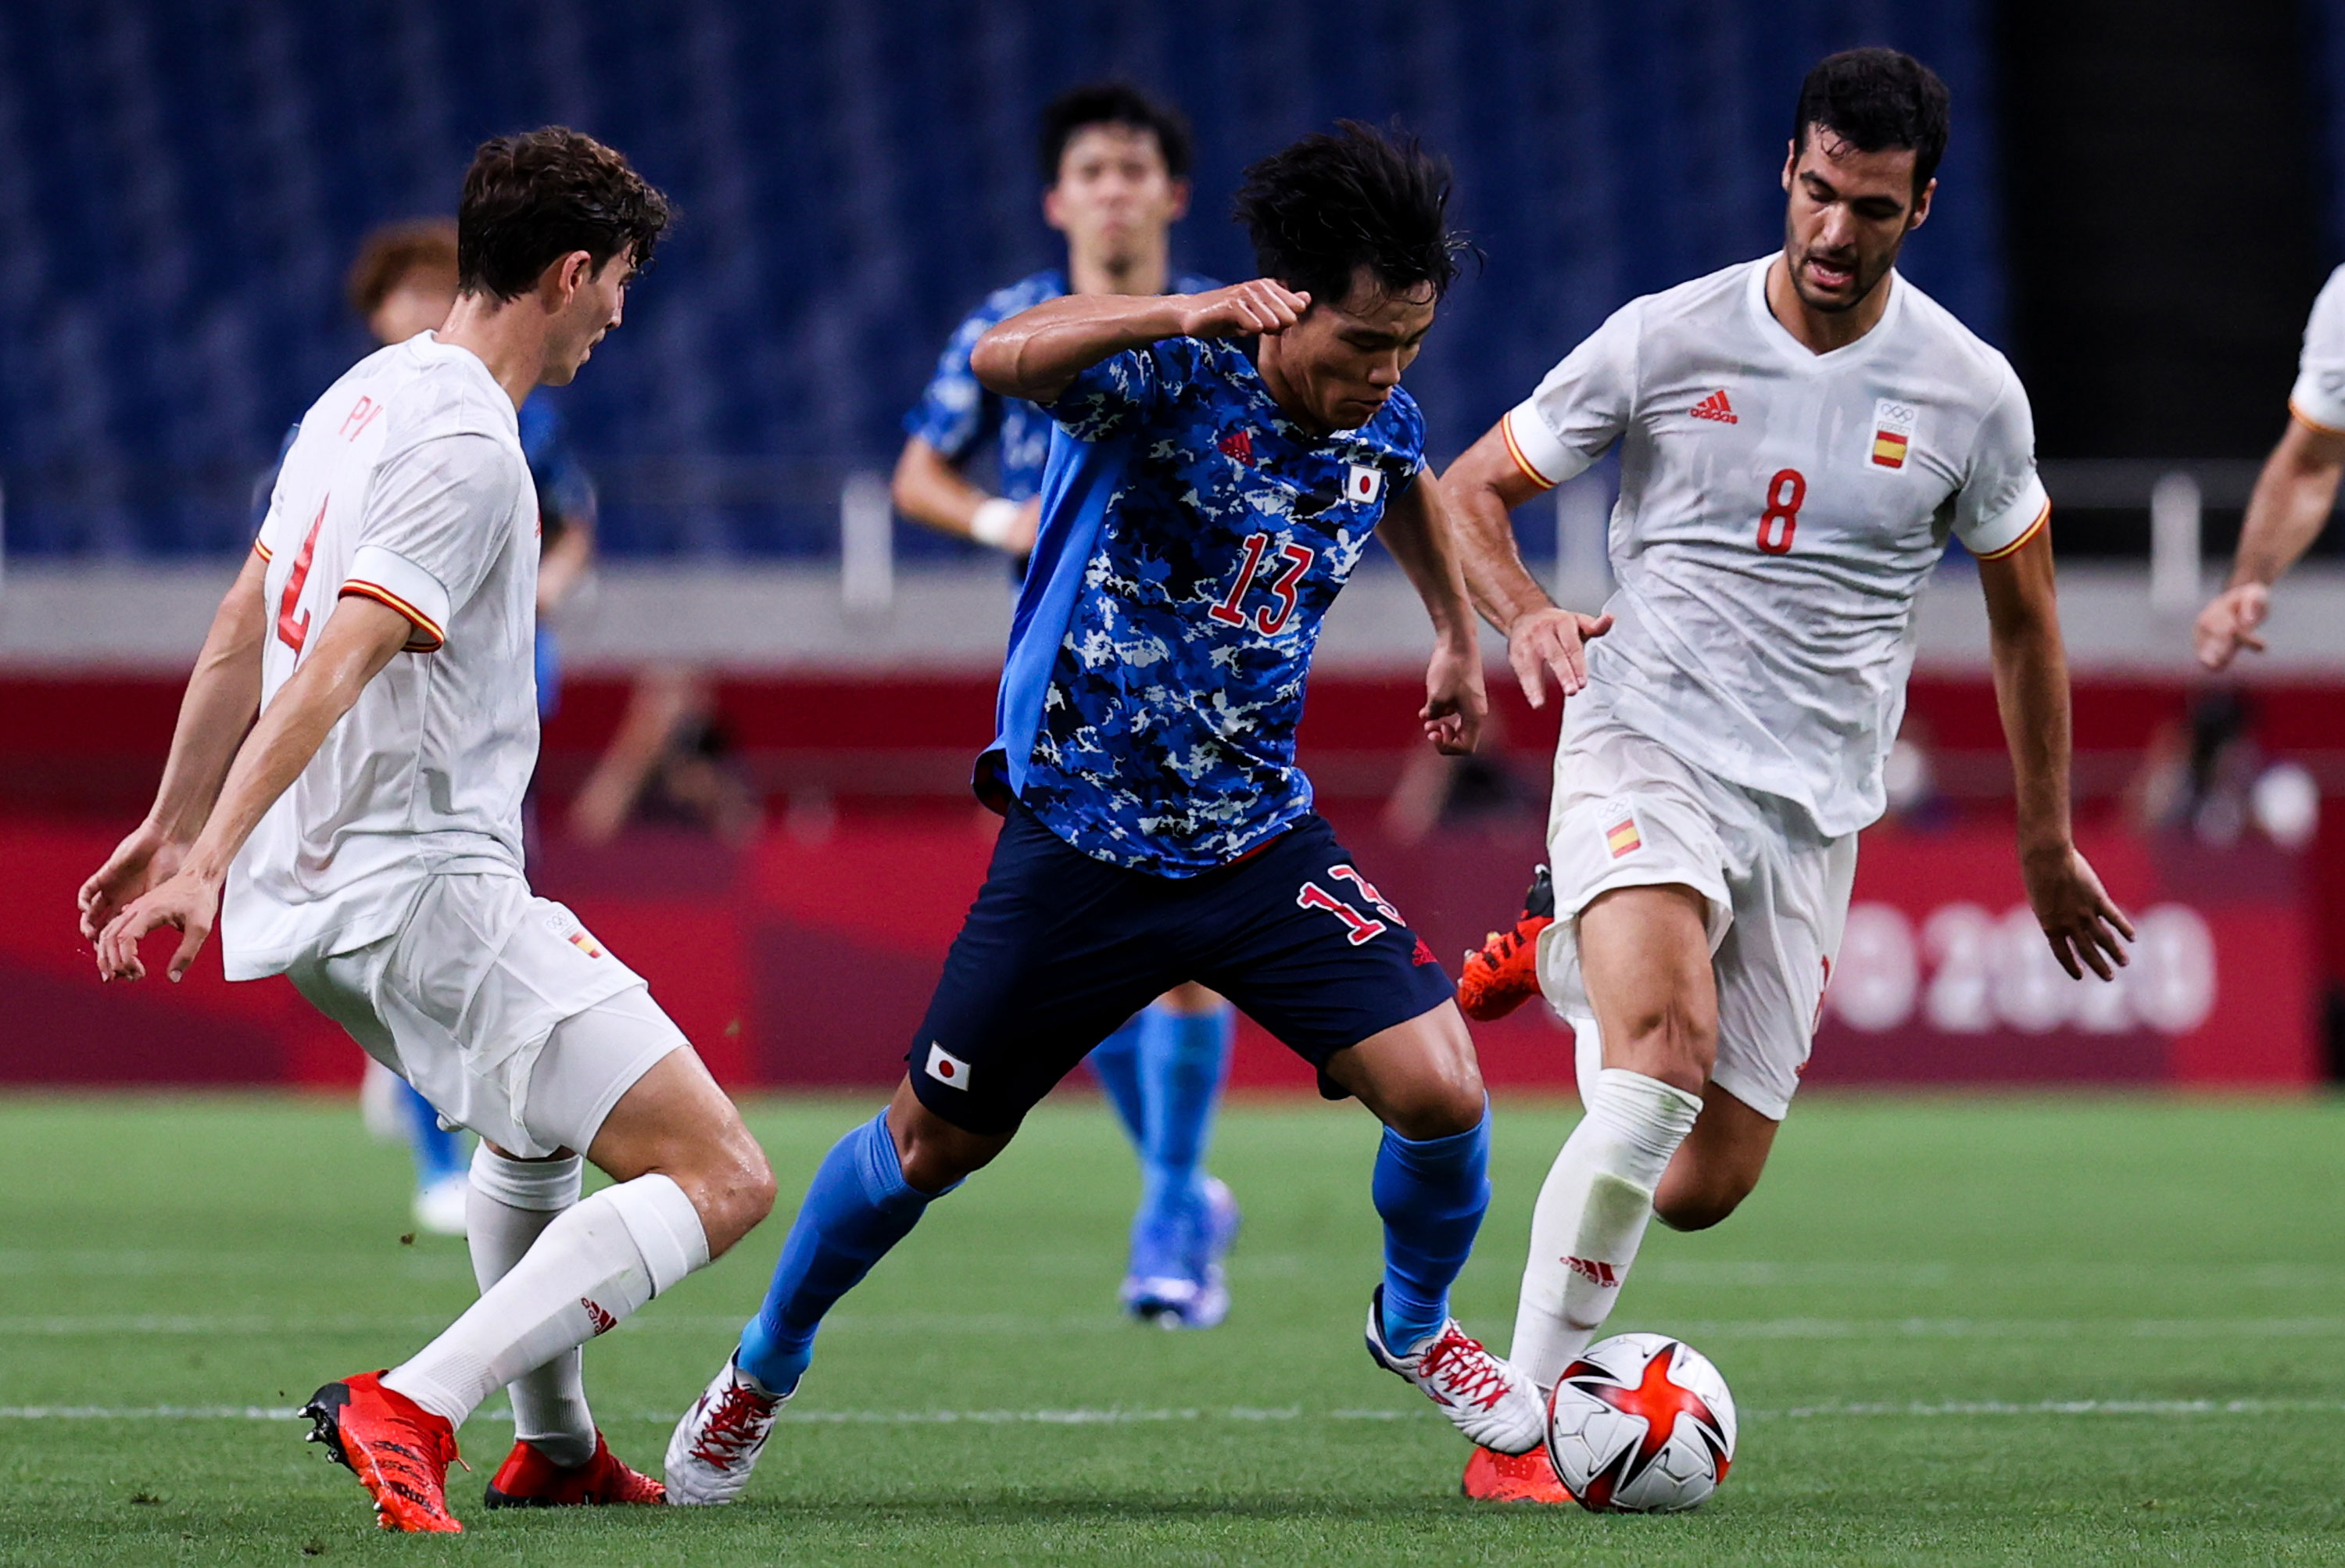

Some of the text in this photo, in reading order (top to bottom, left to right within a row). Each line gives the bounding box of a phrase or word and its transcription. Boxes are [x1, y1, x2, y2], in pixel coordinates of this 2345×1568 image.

[1690, 407, 1738, 424] adidas
[1756, 467, 1807, 556] 8
[1208, 532, 1315, 637] 13
[1296, 864, 1407, 946] 13
